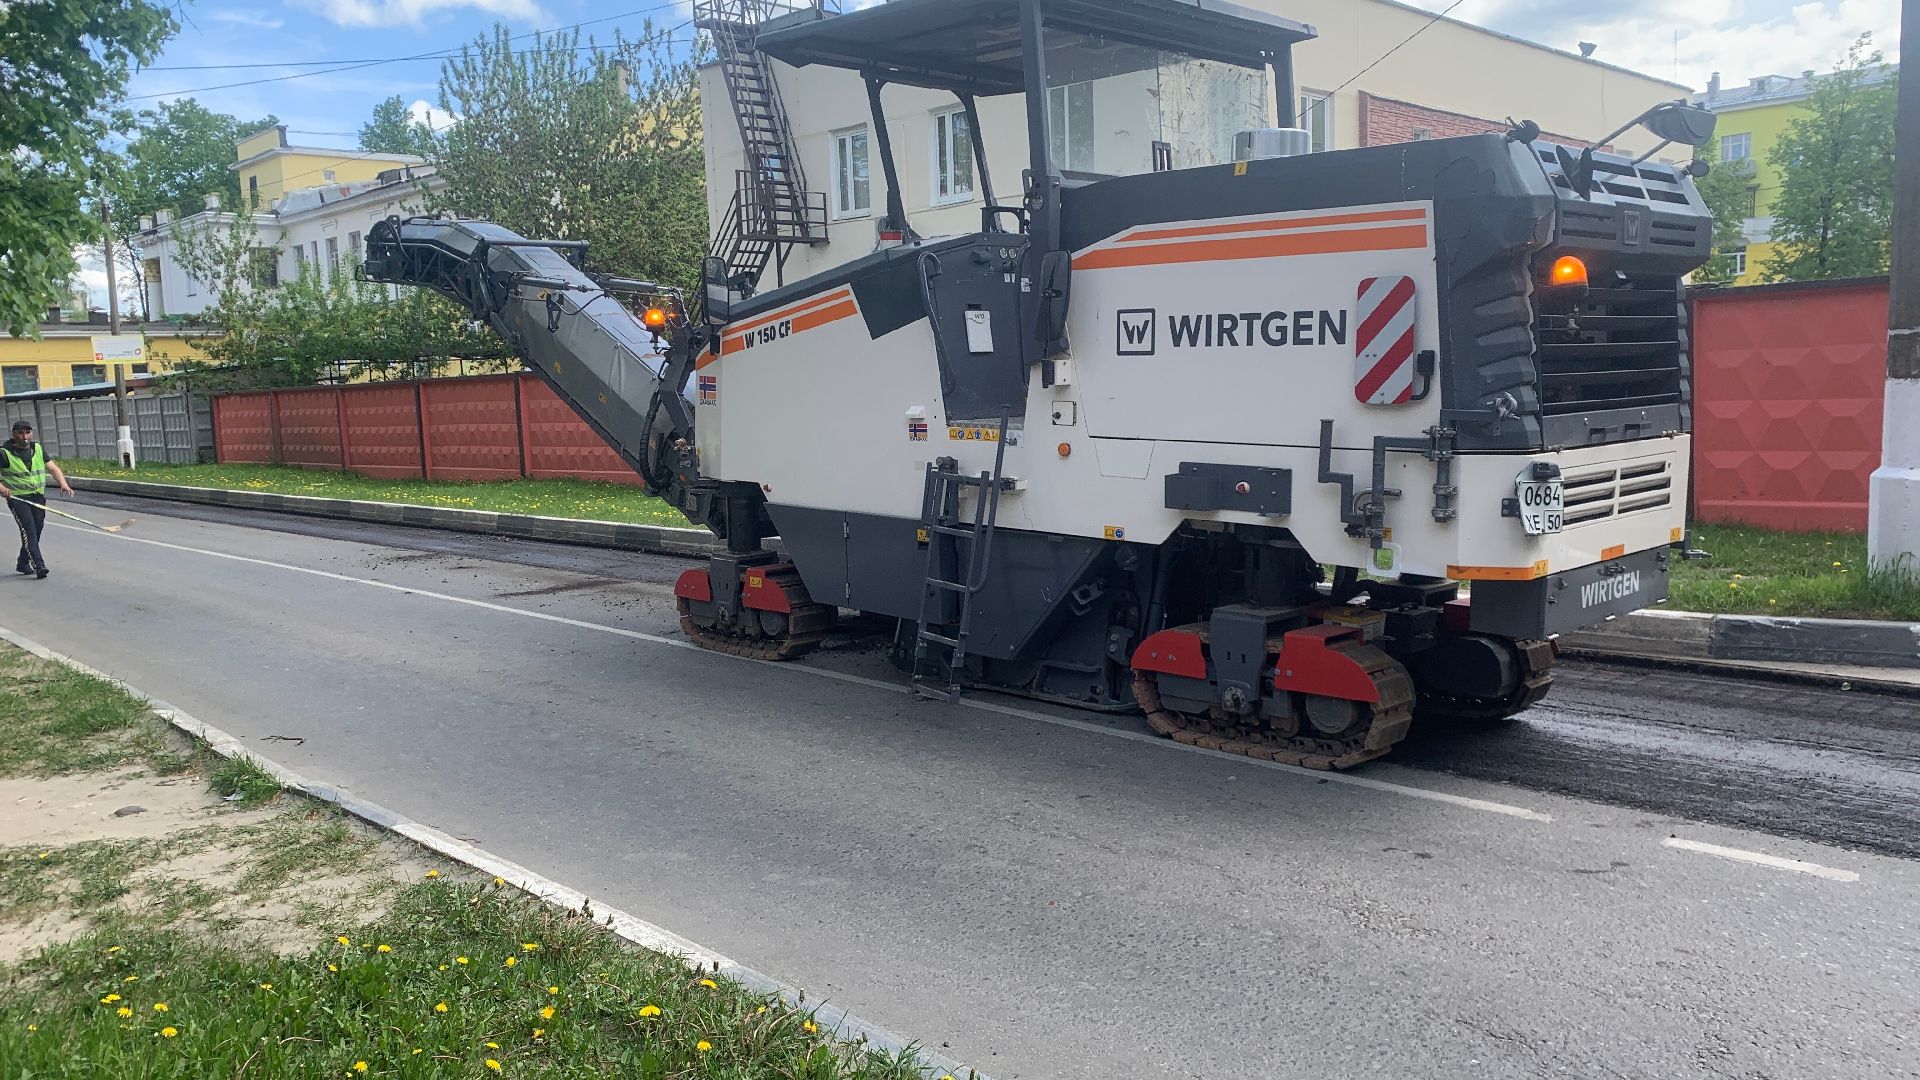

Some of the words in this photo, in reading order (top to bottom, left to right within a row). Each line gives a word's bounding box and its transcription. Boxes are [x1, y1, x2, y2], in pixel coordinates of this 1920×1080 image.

[745, 331, 755, 349] W
[757, 325, 776, 345] 150
[779, 320, 791, 339] CF
[1168, 309, 1347, 348] WIRTGEN
[1525, 485, 1560, 507] 0684
[1547, 514, 1561, 530] 50
[1581, 569, 1640, 609] WIRTGEN
